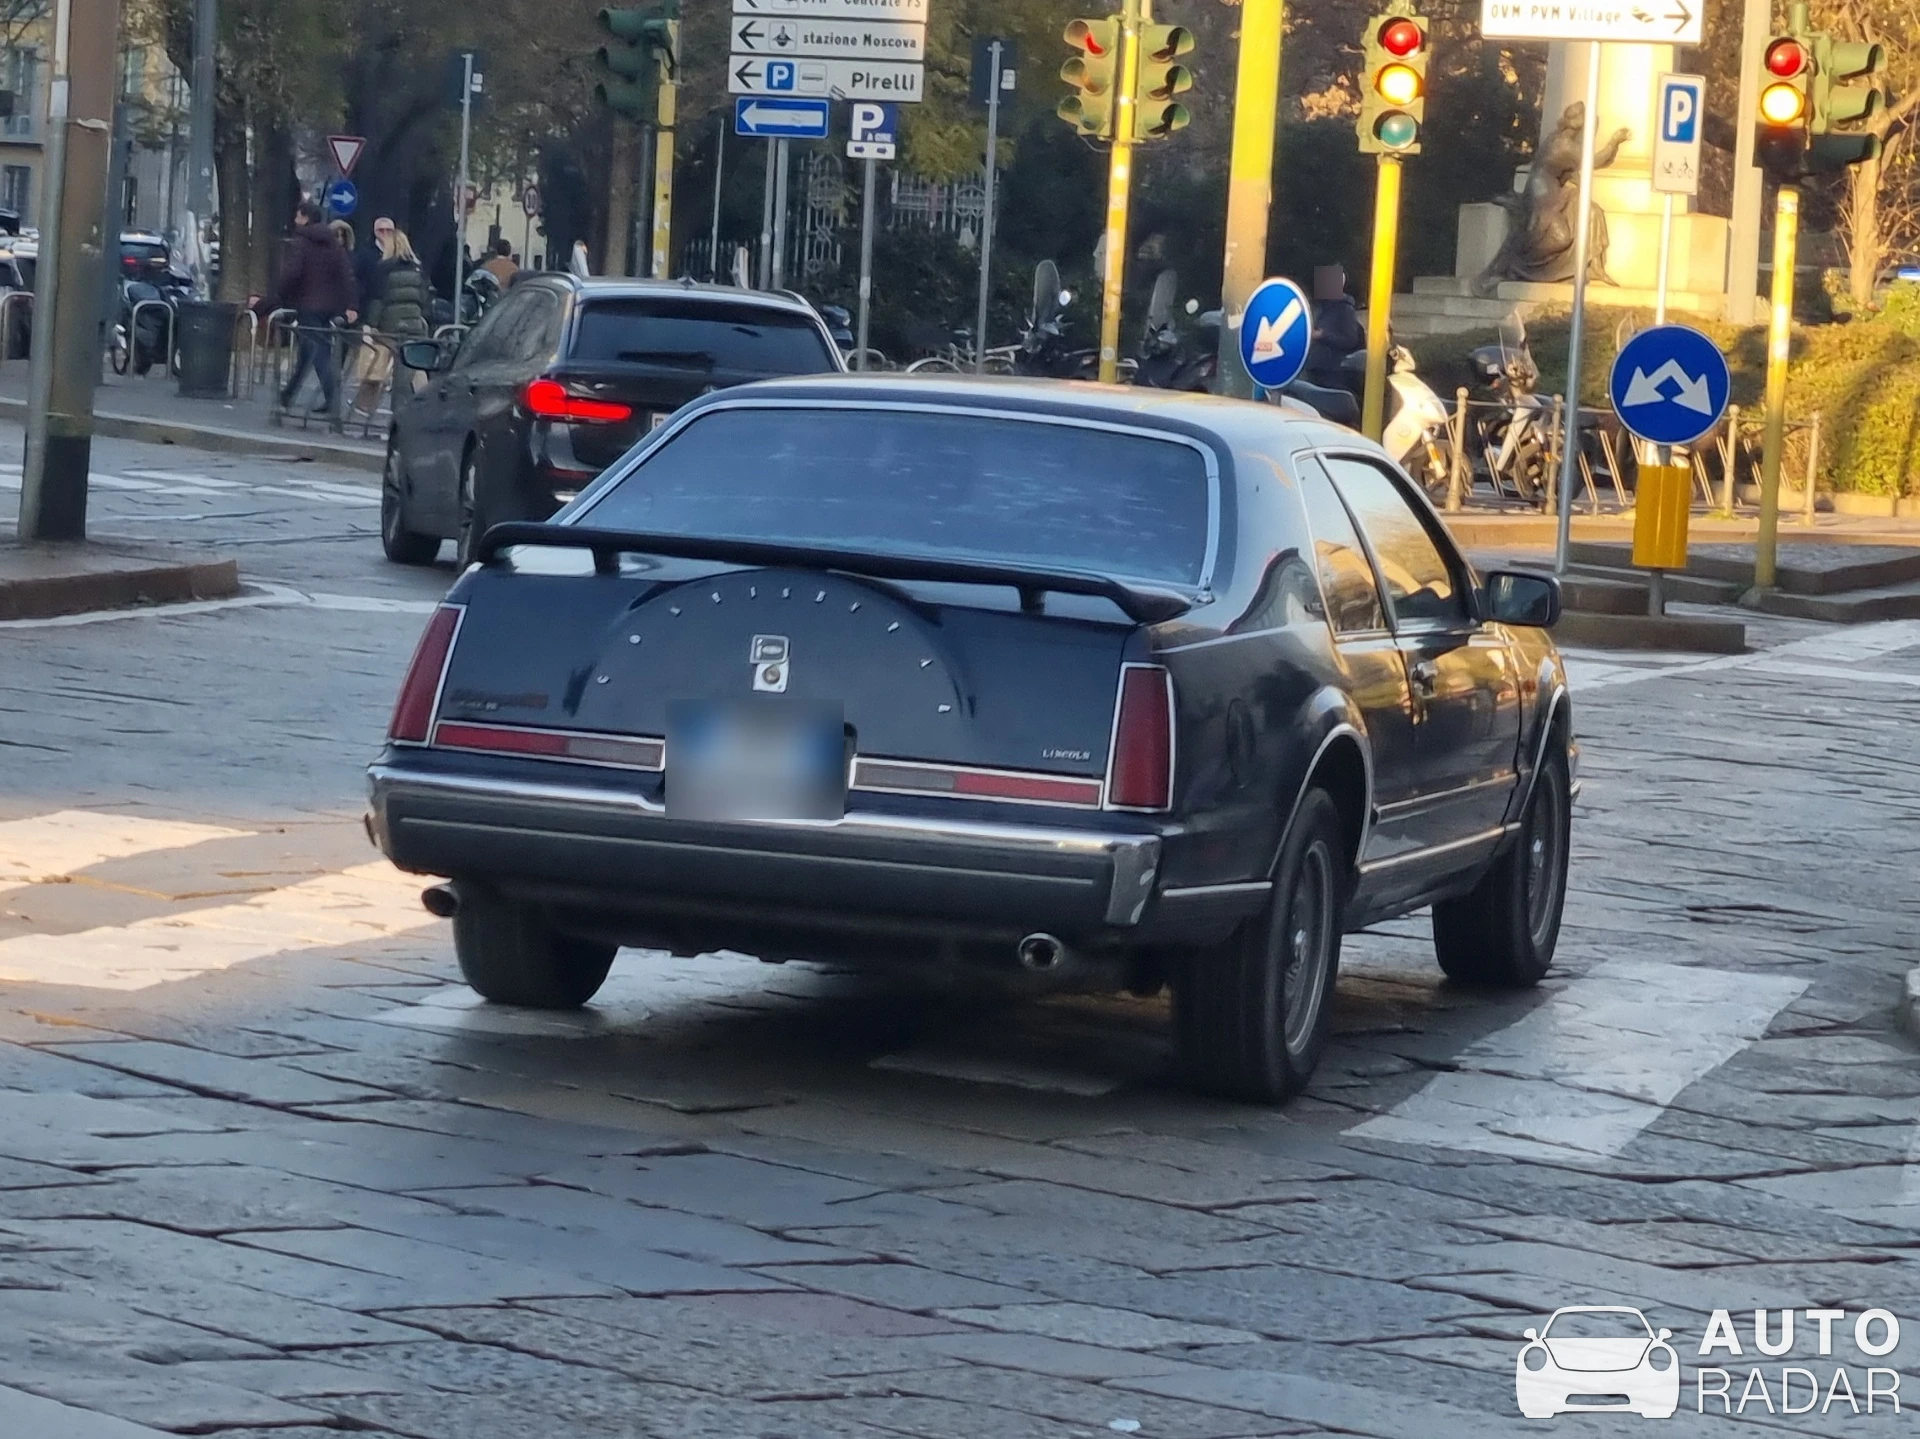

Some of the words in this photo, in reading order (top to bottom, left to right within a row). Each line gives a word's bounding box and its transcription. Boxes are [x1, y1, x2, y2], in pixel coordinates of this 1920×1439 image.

[1568, 5, 1622, 25] Village
[803, 32, 857, 47] stazione
[863, 33, 917, 49] Moscova
[772, 65, 790, 87] P
[851, 72, 915, 91] Pirelli
[852, 103, 885, 141] P
[1669, 89, 1692, 137] P
[1042, 748, 1091, 761] LINCOLN
